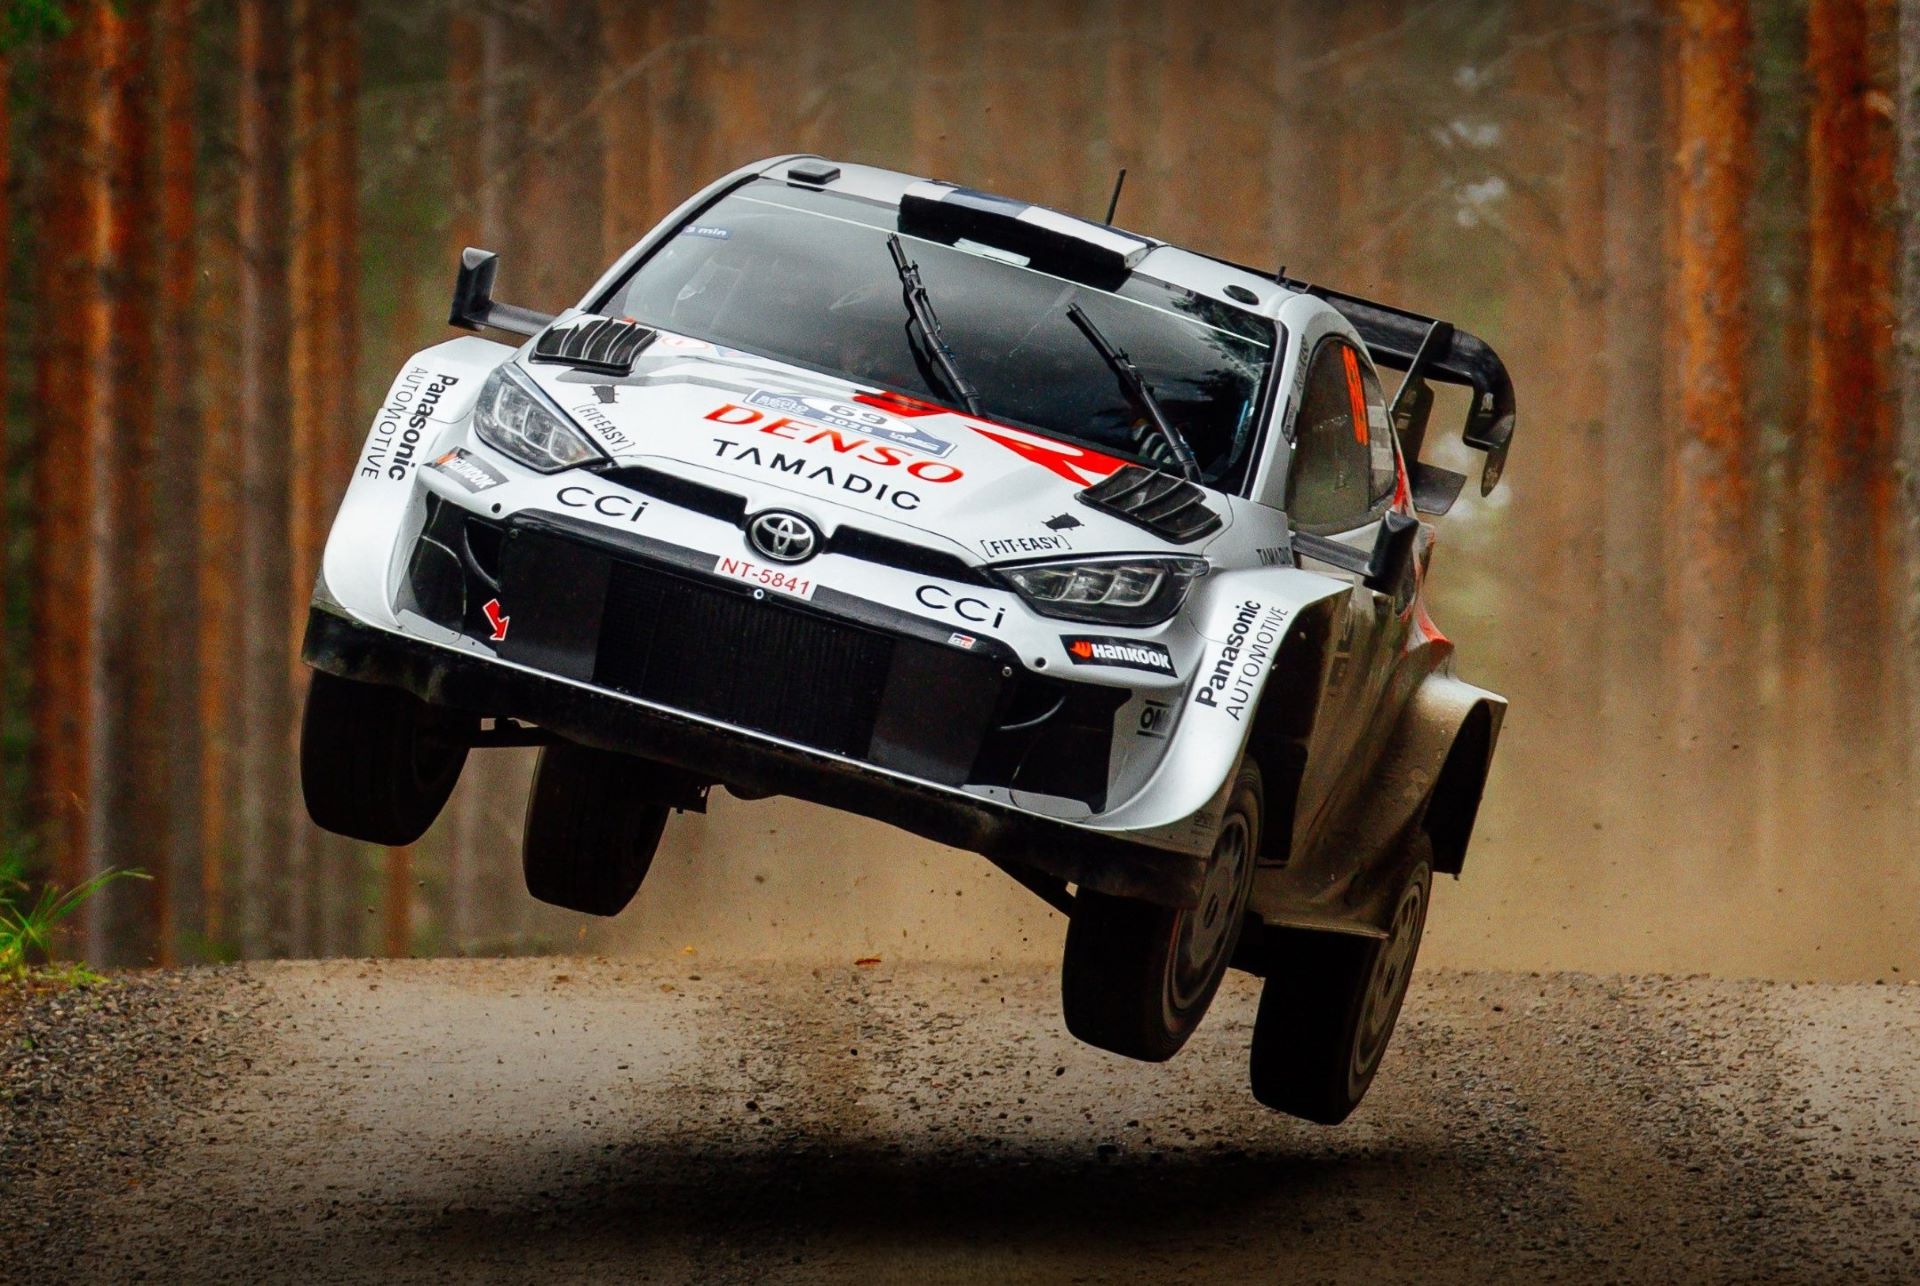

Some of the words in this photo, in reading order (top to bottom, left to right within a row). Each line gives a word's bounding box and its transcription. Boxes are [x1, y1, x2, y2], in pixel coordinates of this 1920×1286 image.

[361, 366, 429, 479] AUTOMOTIVE
[388, 374, 459, 480] Panasonic
[703, 404, 965, 483] DENSO
[821, 415, 874, 433] 2025
[829, 404, 888, 425] 69
[556, 486, 650, 522] CCi
[712, 438, 921, 511] TAMADIC
[721, 557, 810, 595] NT-5841
[915, 584, 1007, 629] CCi
[1195, 600, 1261, 708] Panasonic
[1226, 606, 1288, 721] AUTOMOTIVE
